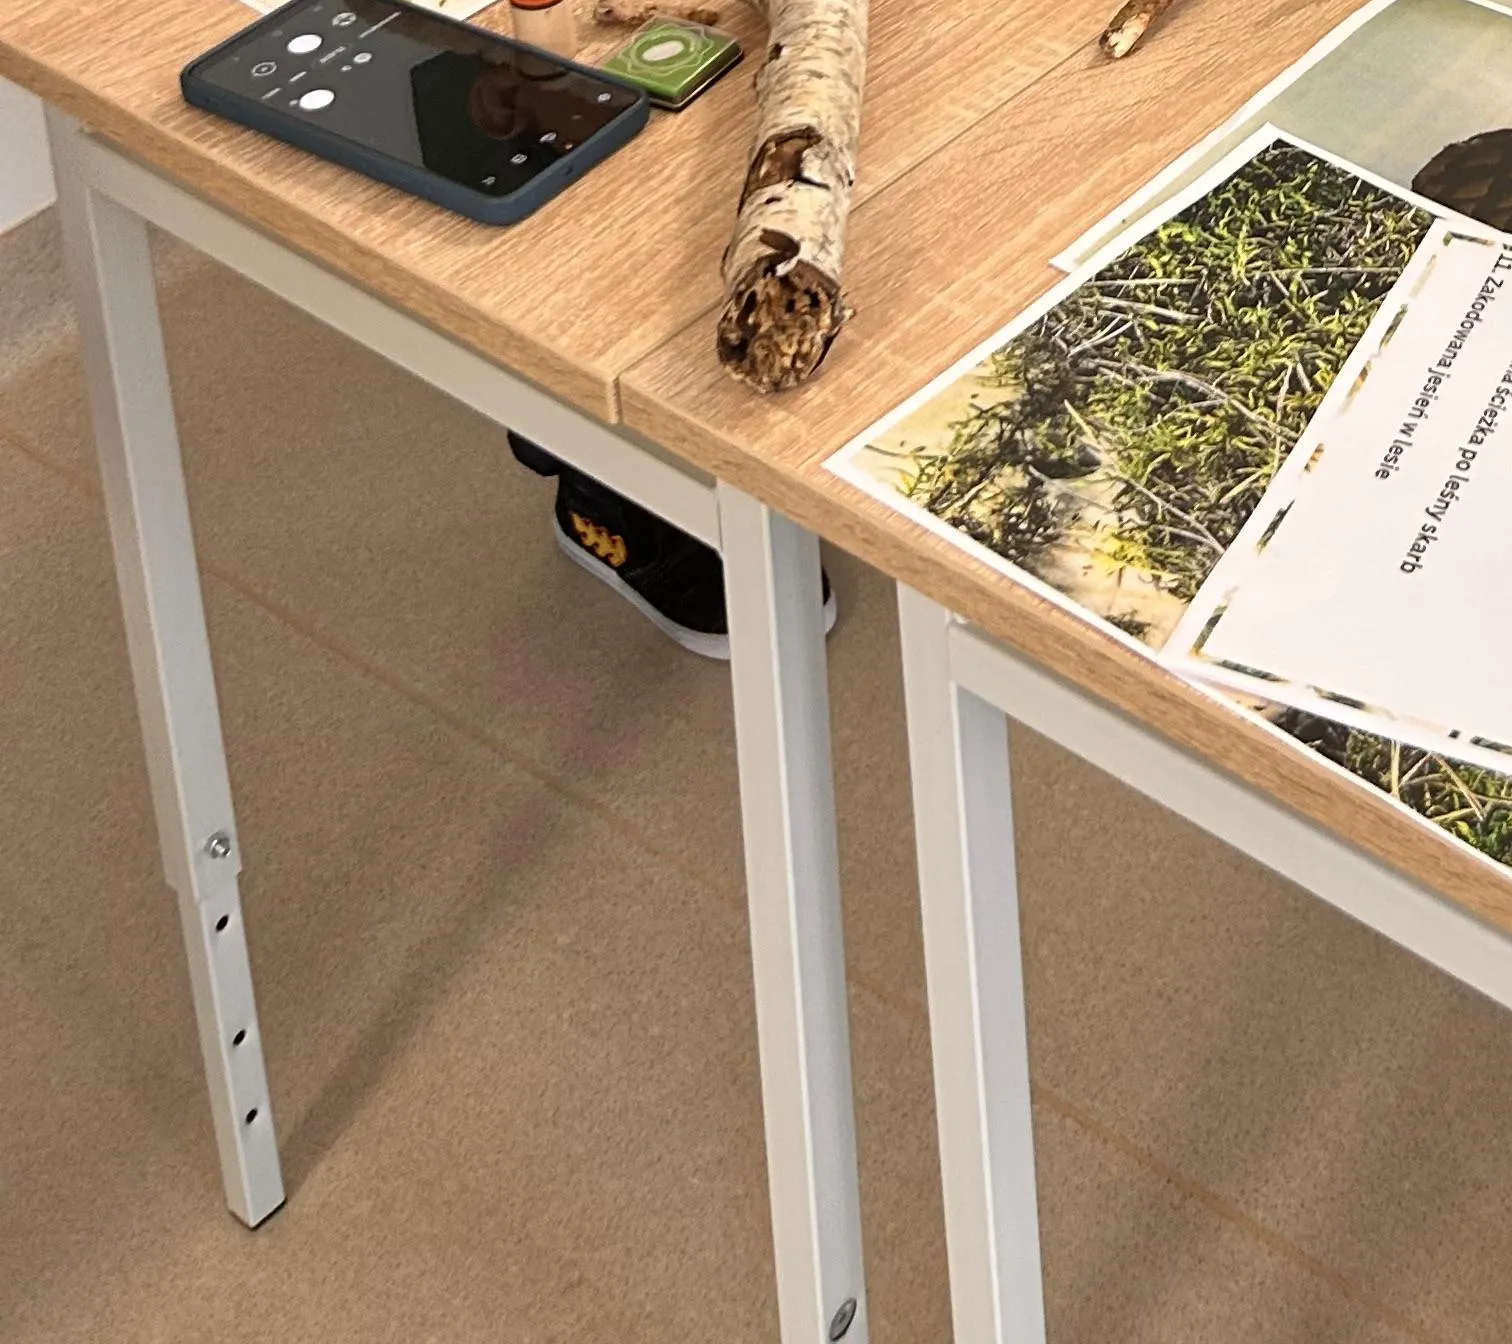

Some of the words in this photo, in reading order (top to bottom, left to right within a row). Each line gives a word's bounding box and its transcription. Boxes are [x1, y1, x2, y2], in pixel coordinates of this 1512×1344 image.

[1437, 275, 1504, 368] Zakodowana
[1408, 367, 1451, 419] jesień
[1467, 385, 1512, 447] ścieżka
[1399, 422, 1418, 437] w
[1375, 439, 1413, 480] lesie
[1455, 446, 1478, 472] po
[1425, 474, 1470, 522] leśny
[1400, 522, 1439, 575] skarb
